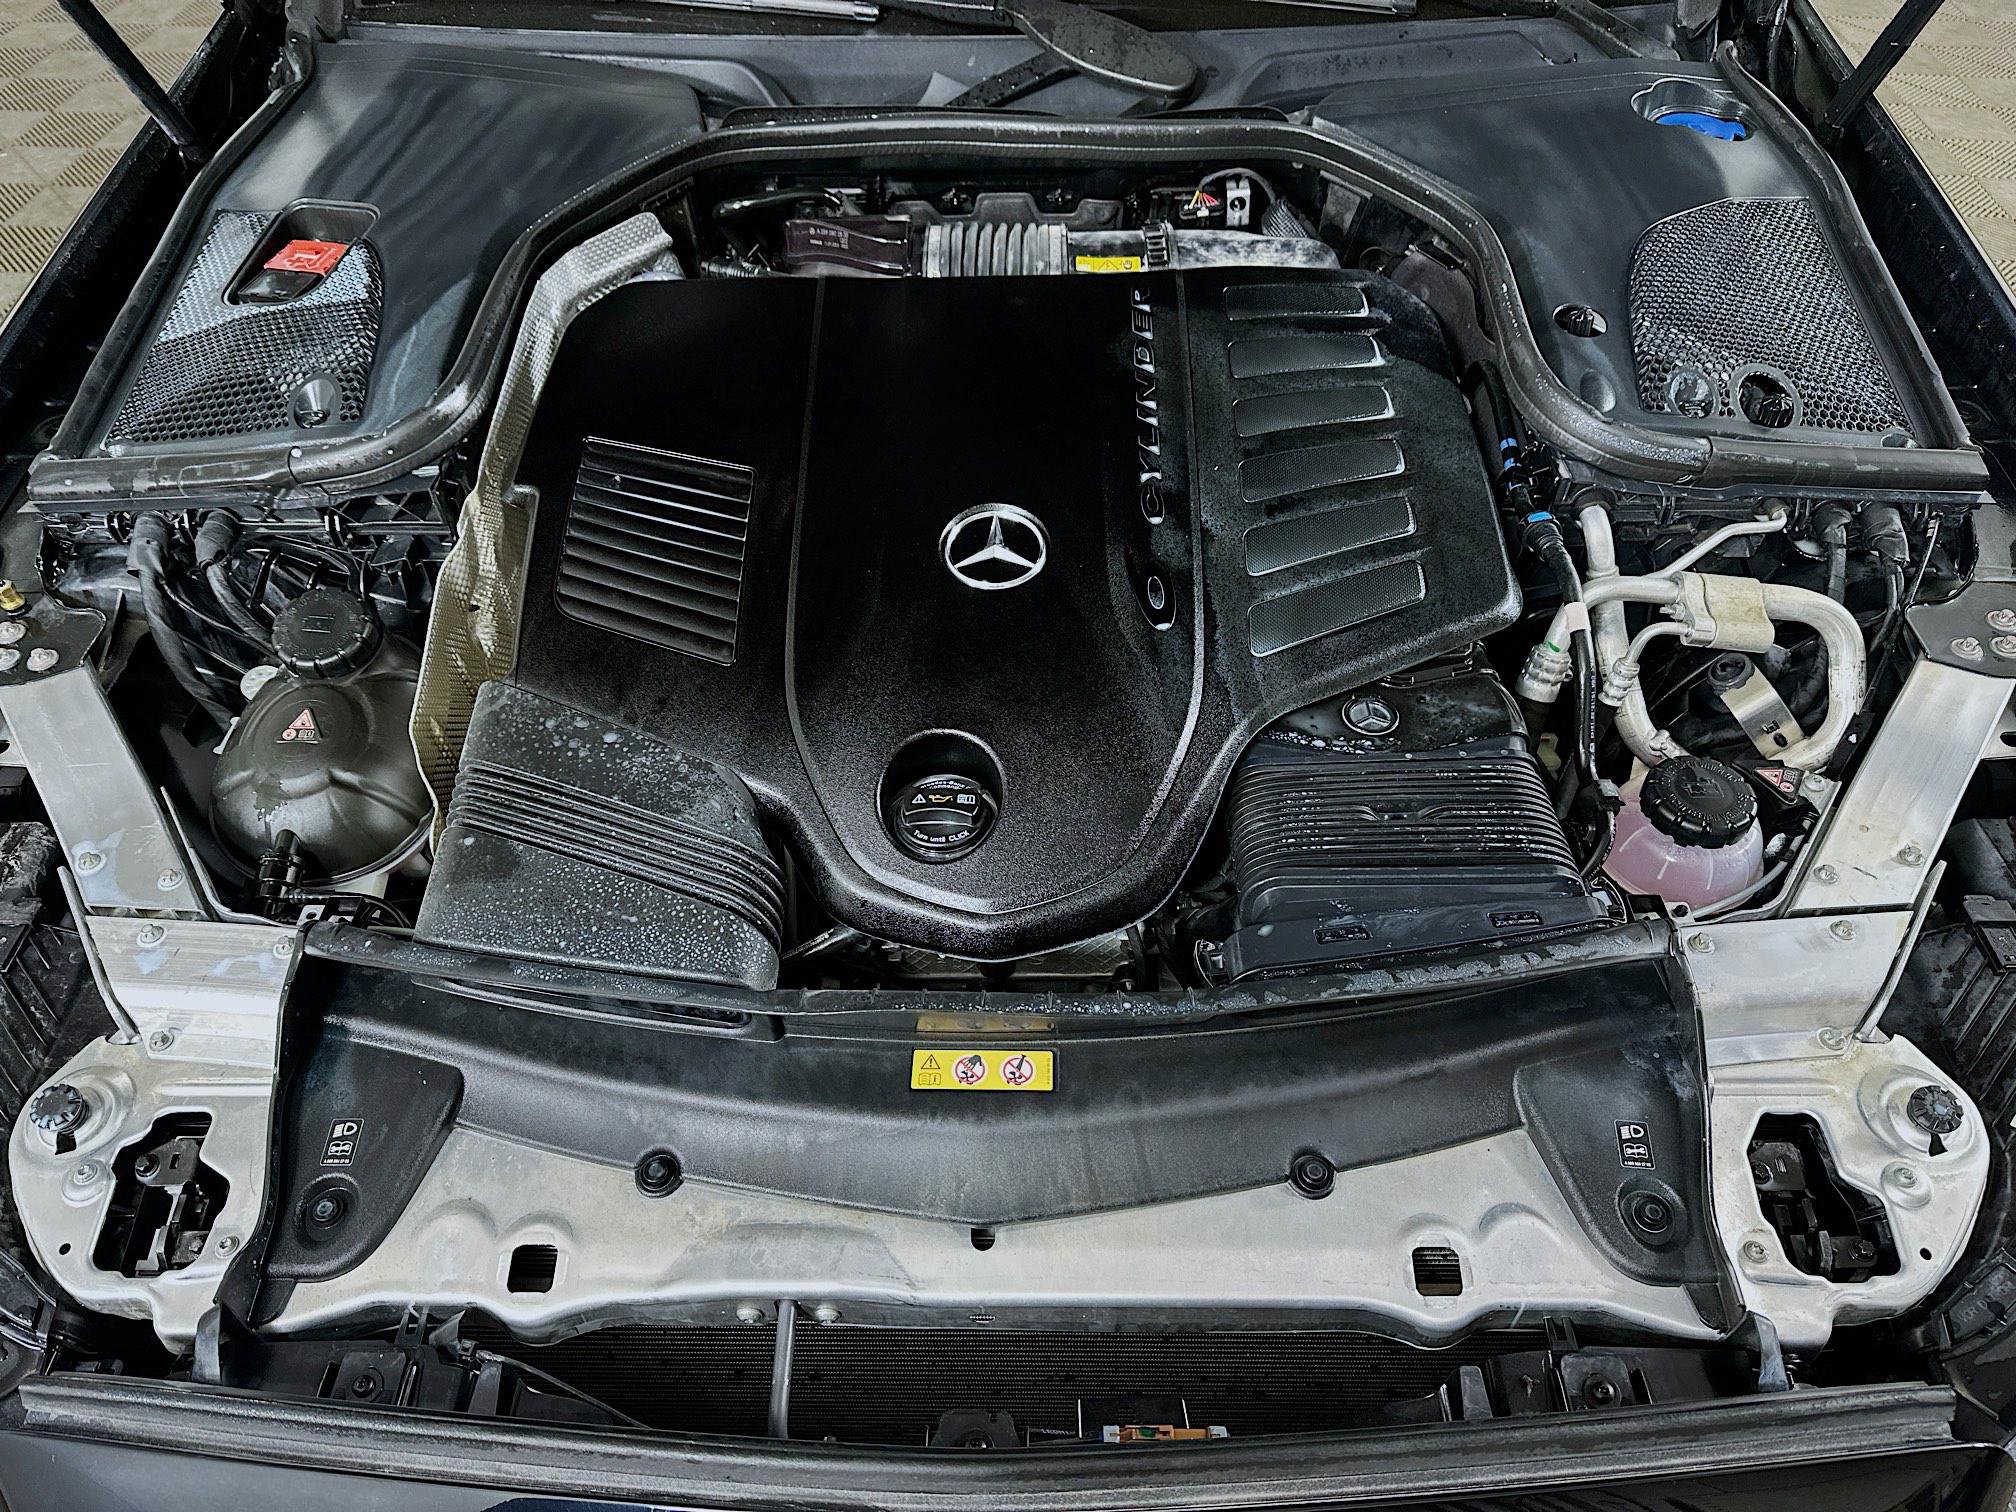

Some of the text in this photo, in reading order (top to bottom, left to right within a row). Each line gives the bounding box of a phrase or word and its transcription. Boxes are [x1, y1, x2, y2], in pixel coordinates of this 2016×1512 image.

[1131, 287, 1165, 525] CYLINDER
[913, 829, 928, 840] Turn
[948, 830, 970, 841] CLICK
